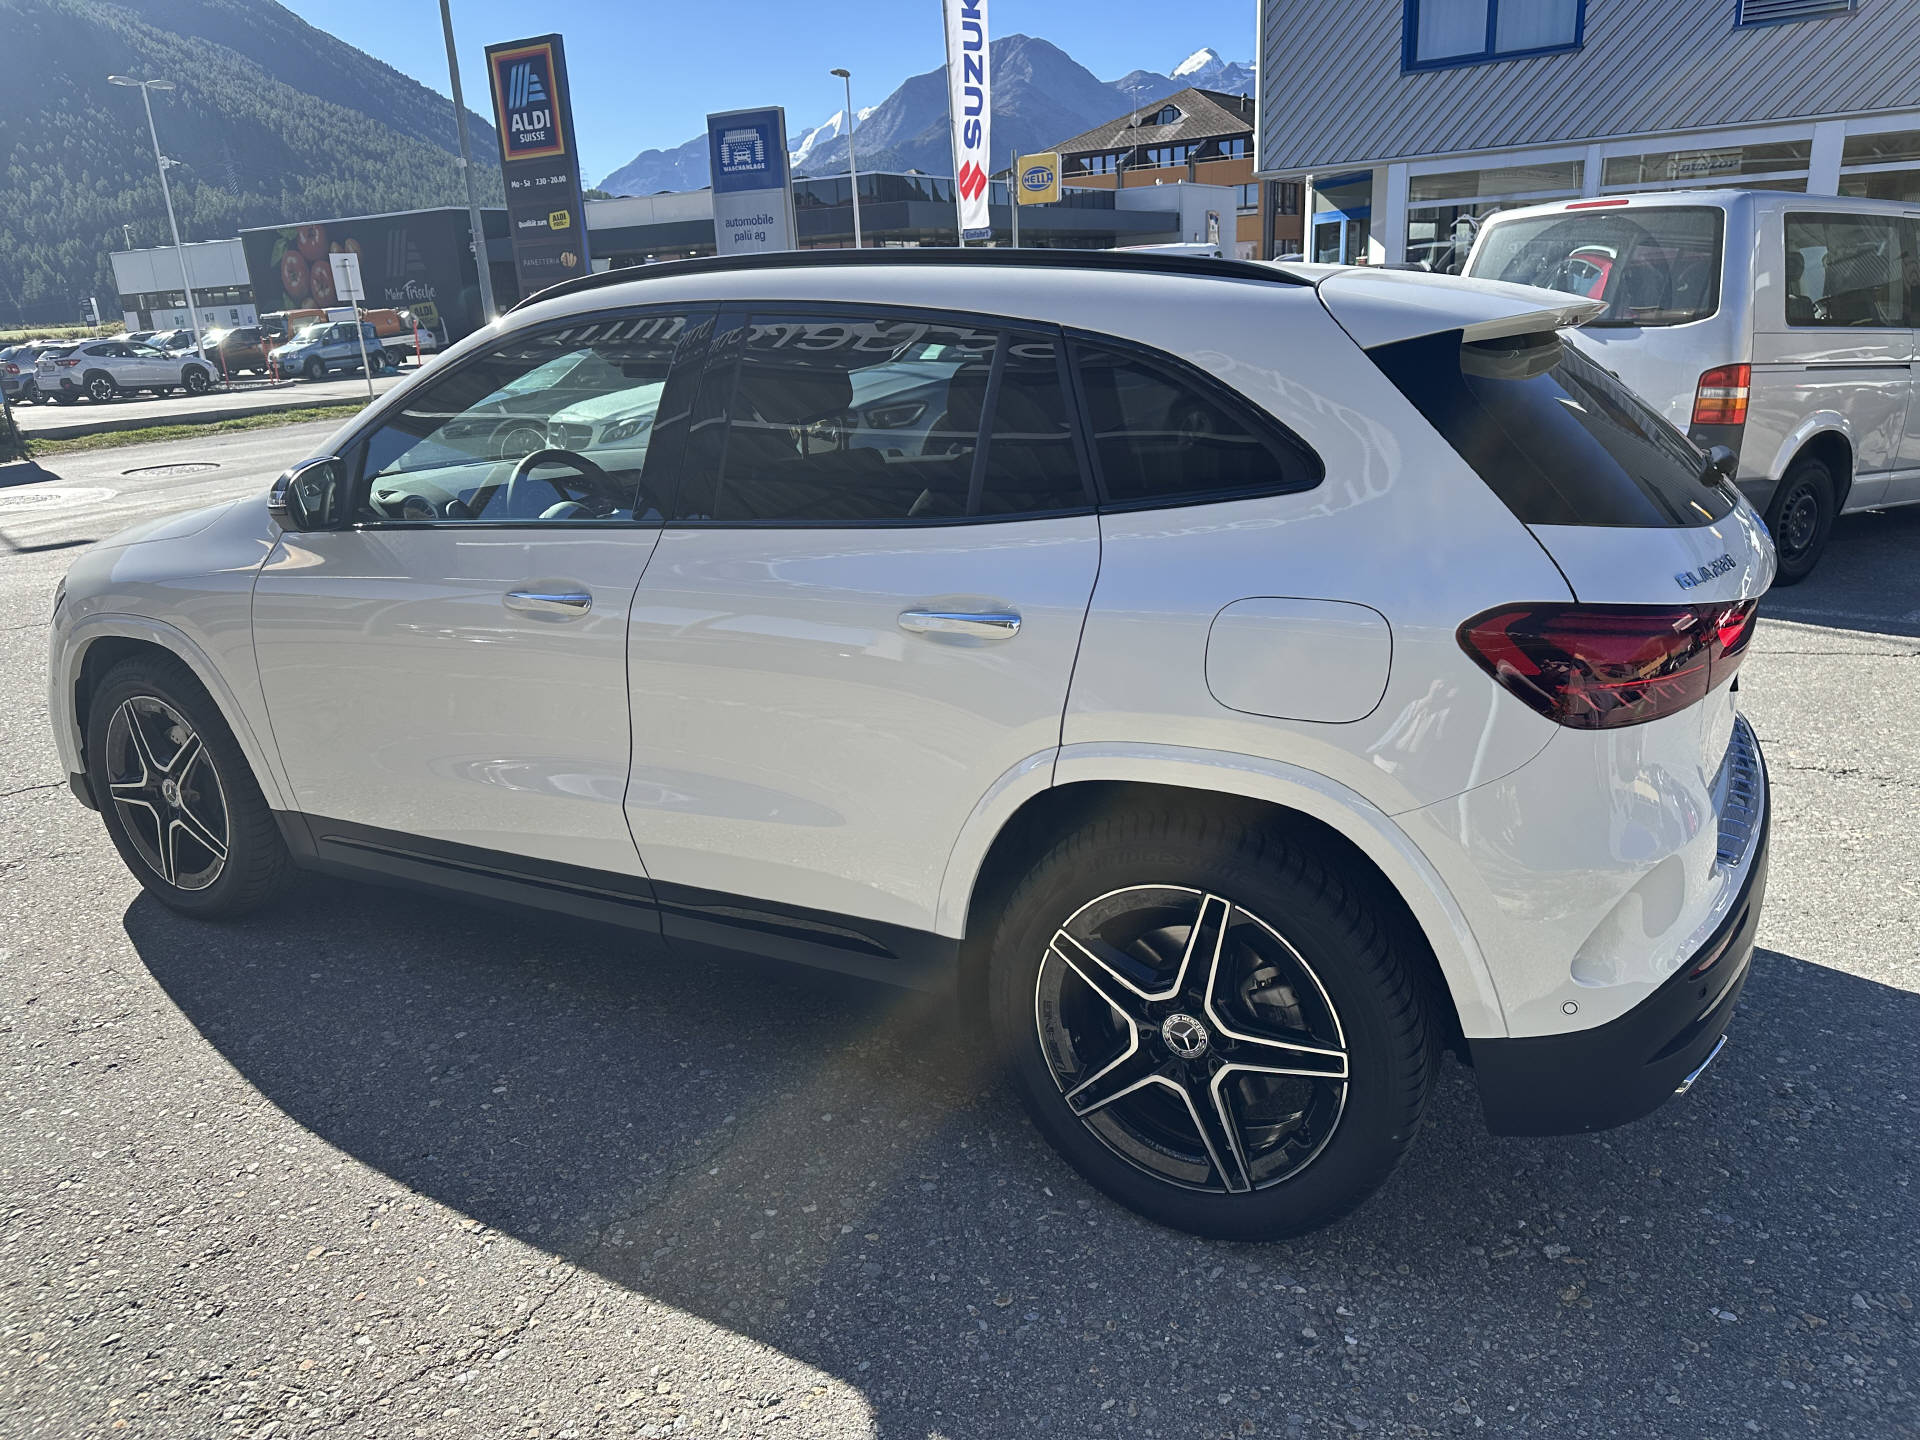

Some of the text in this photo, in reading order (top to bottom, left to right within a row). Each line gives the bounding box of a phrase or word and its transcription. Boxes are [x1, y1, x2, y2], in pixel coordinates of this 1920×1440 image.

[511, 109, 551, 133] ALDI
[519, 130, 545, 143] SUISSE
[723, 163, 765, 173] WASCHANLAGE
[1023, 172, 1054, 184] HELLA
[552, 212, 567, 222] ALDI
[725, 213, 774, 228] automobile
[754, 231, 766, 242] ag
[402, 280, 437, 301] Frische
[414, 305, 433, 317] ALDI
[1674, 566, 1715, 590] GLA
